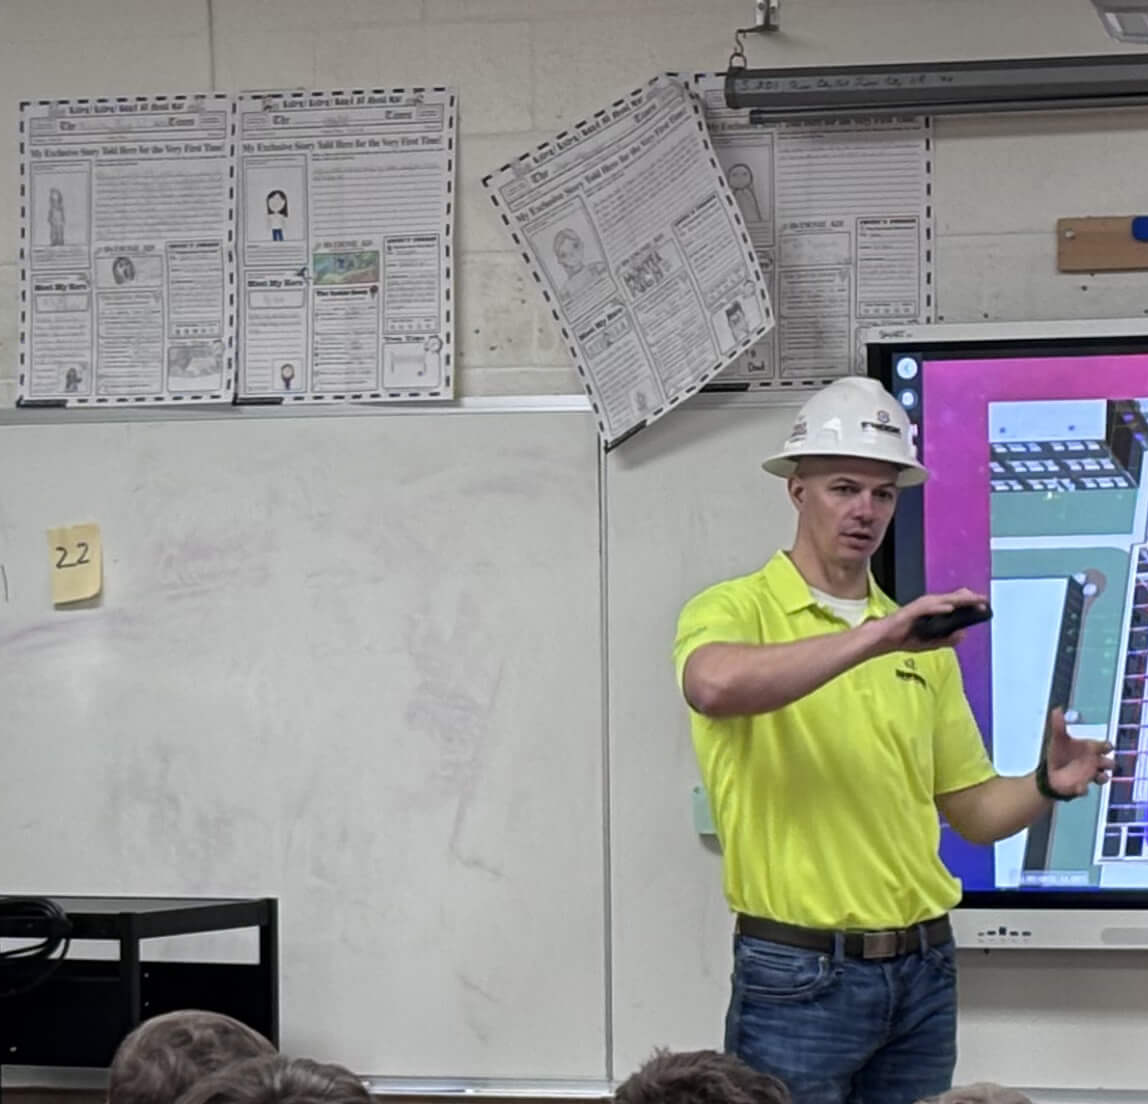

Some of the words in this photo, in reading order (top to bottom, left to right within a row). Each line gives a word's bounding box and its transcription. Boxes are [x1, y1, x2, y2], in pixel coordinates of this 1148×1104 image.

[55, 284, 67, 292] My
[269, 280, 282, 288] My
[55, 542, 91, 569] 22
